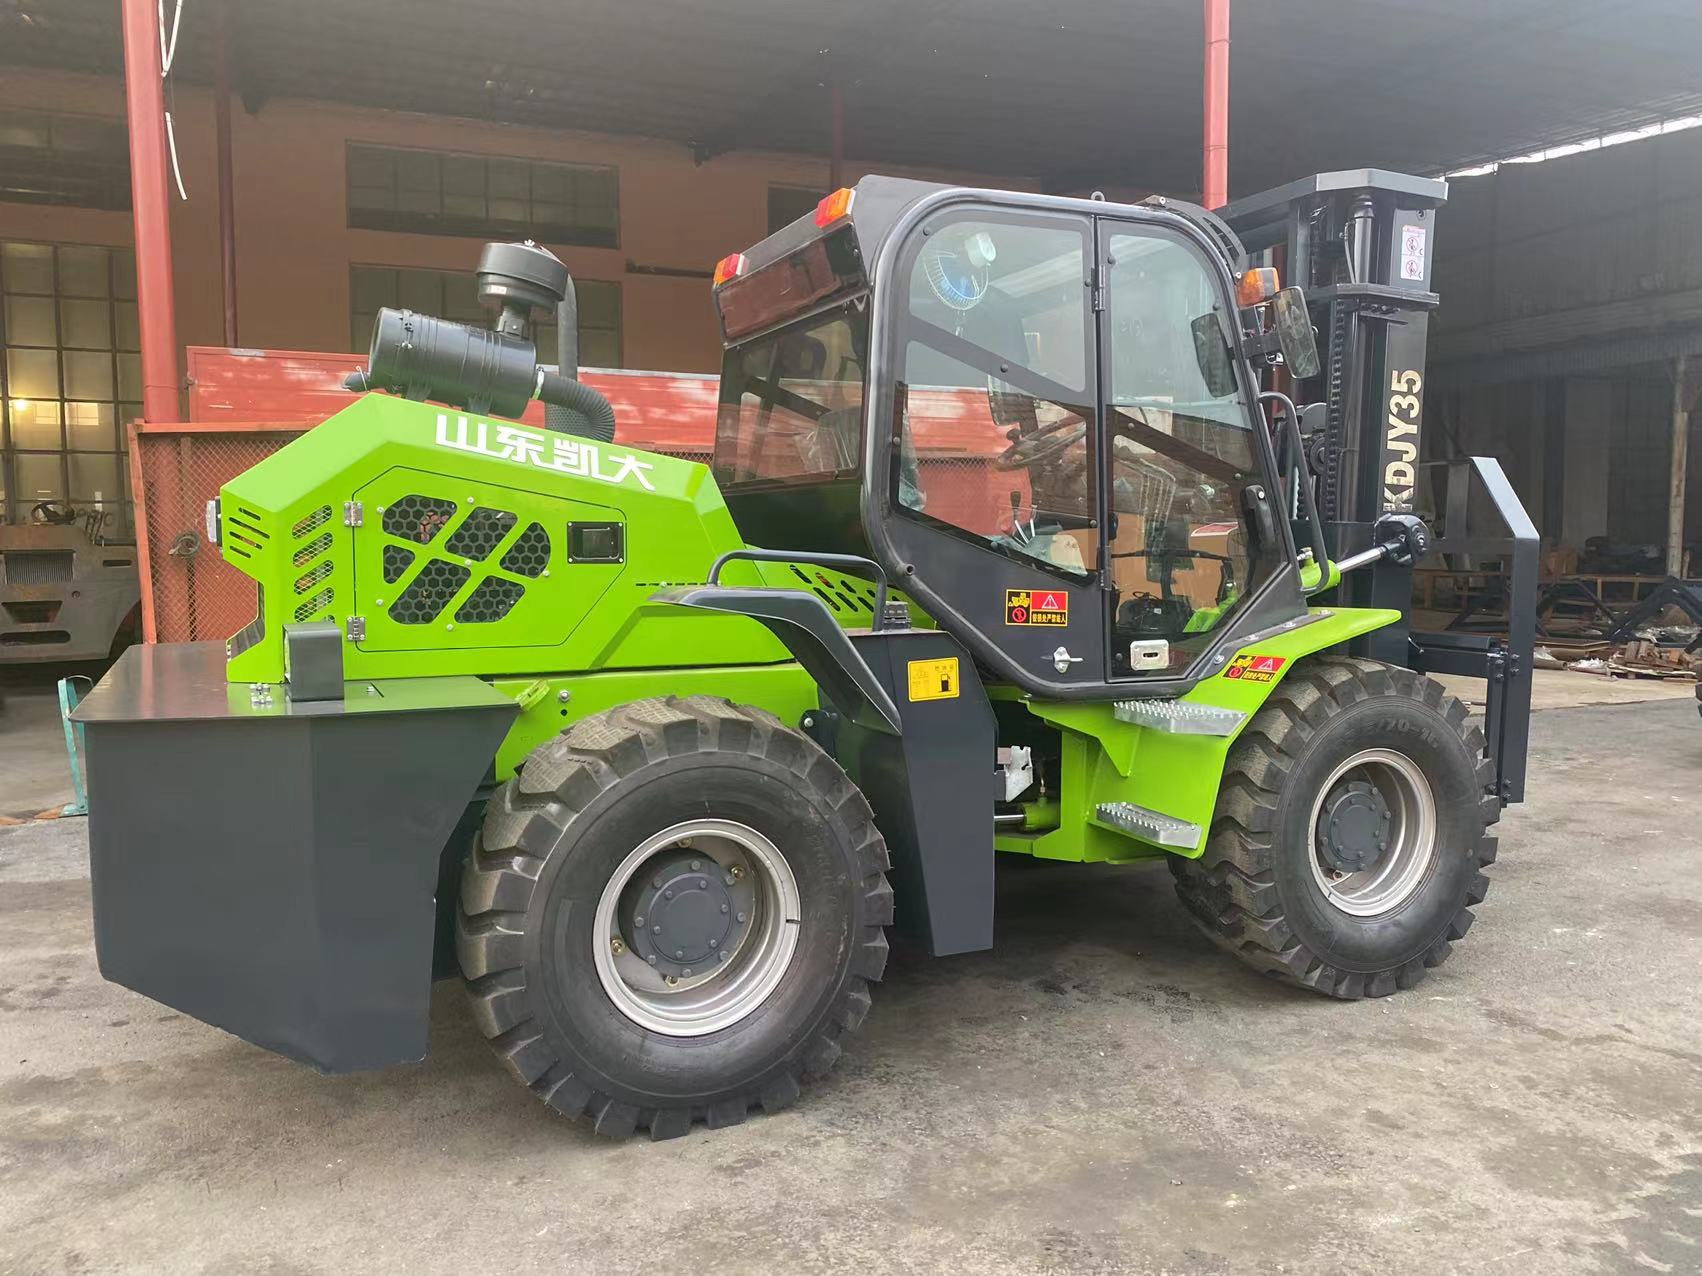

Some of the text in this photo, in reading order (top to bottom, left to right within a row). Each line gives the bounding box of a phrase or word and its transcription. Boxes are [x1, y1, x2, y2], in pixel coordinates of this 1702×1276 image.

[435, 414, 657, 491] 山东凯大
[1382, 369, 1422, 512] KDJY35
